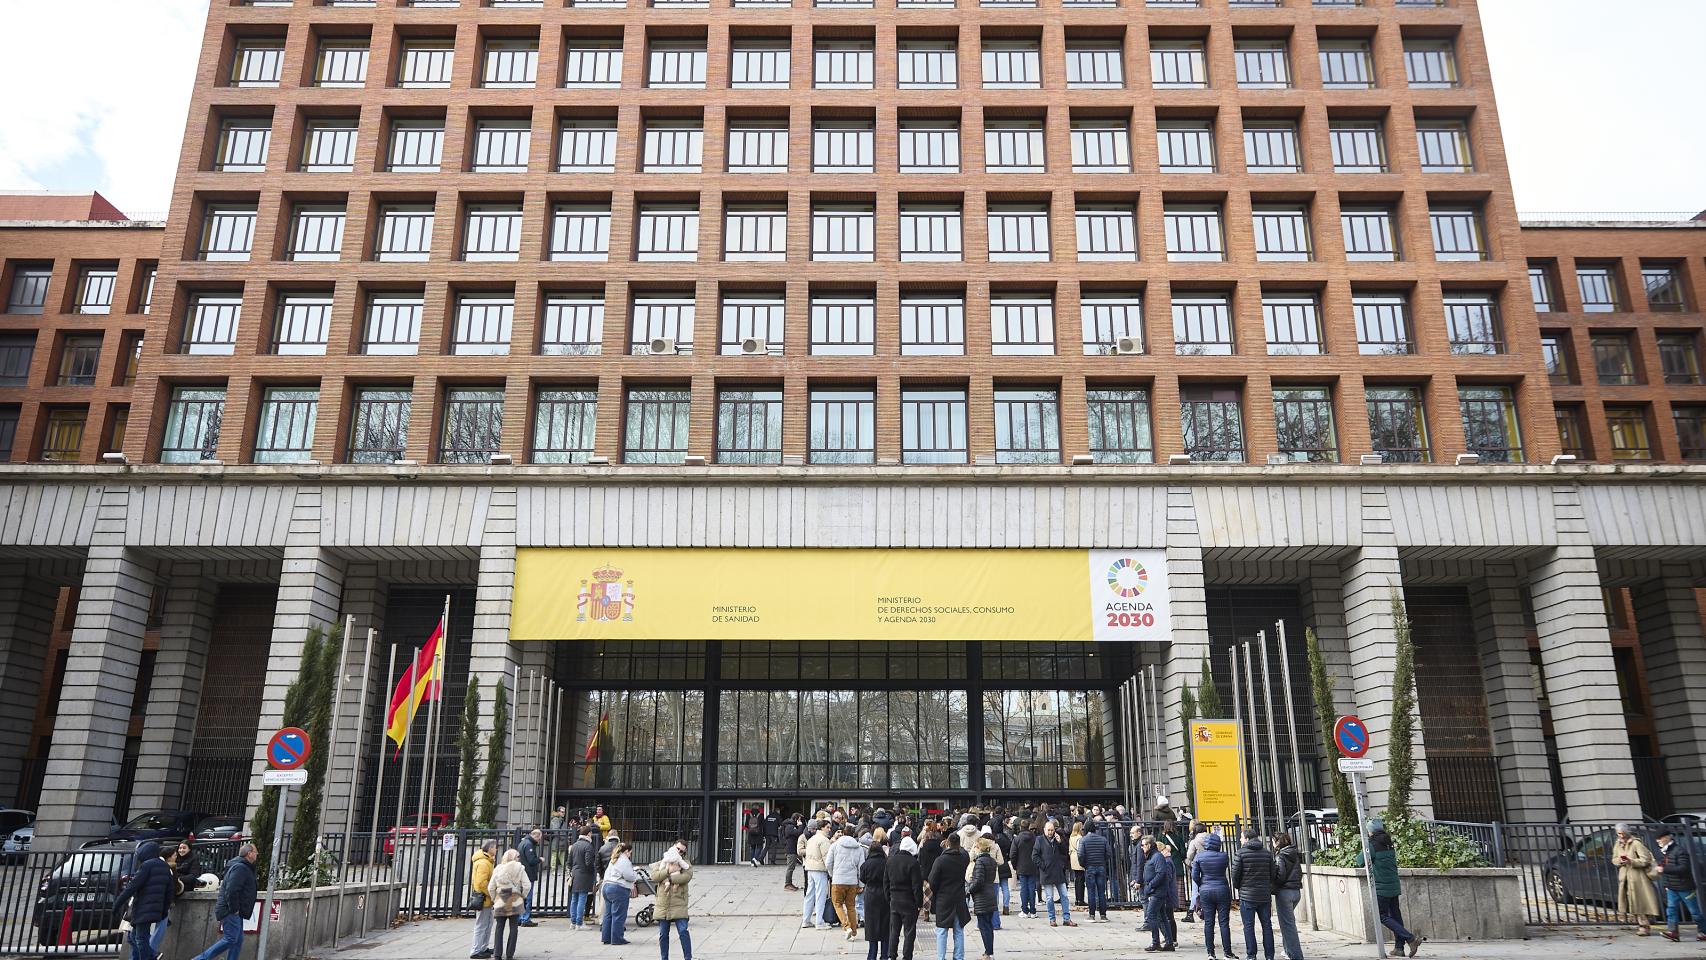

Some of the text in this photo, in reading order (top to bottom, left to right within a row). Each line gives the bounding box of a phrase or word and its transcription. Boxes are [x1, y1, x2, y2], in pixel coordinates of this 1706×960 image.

[877, 606, 889, 614] DE
[890, 606, 933, 614] DERECHOS
[972, 606, 1015, 614] CONSUMO
[1106, 603, 1154, 611] AGENDA
[712, 615, 760, 623] DE SANIDAD
[1106, 612, 1155, 627] 2030
